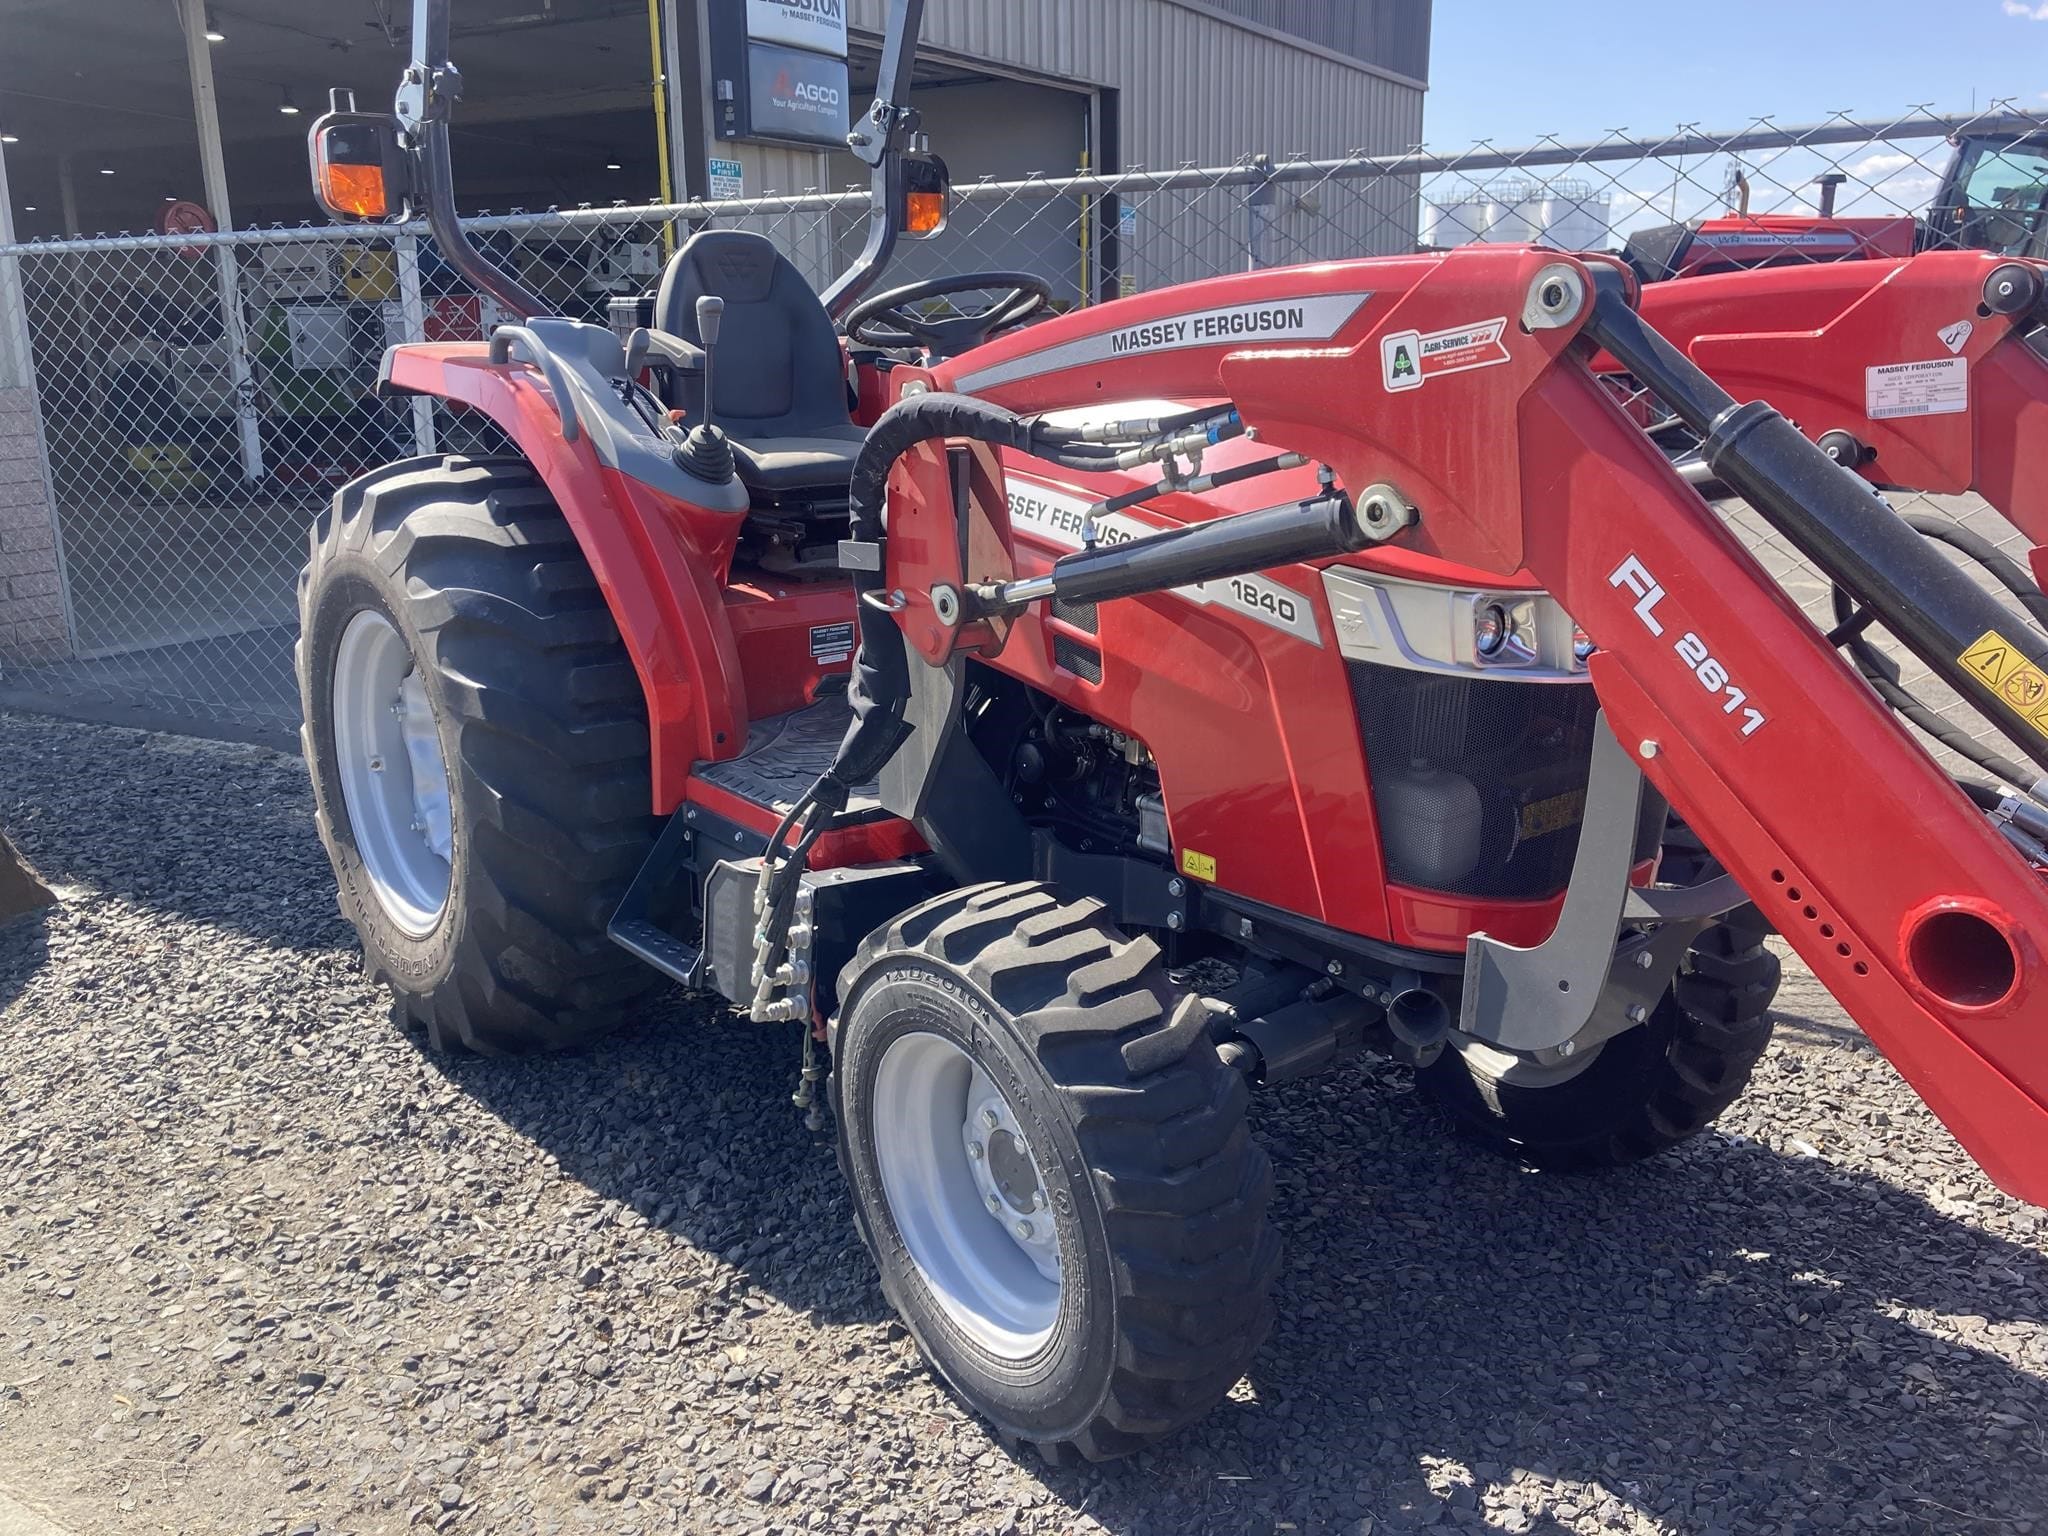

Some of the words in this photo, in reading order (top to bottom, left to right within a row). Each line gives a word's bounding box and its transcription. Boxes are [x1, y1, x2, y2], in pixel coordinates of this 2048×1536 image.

[758, 0, 841, 18] STON
[789, 9, 815, 21] MASSEY
[795, 82, 839, 105] AGCO
[772, 97, 786, 108] Your
[787, 100, 817, 112] Agriculture
[711, 161, 739, 171] SAFETY
[1111, 320, 1187, 353] MASSEY
[1193, 308, 1304, 339] FERGUSON
[1423, 335, 1469, 354] AGRI-SERVICE
[1877, 365, 1910, 375] MASSEY
[1911, 360, 1954, 371] FERGUSON
[1007, 493, 1048, 521] SSEY
[1050, 507, 1138, 546] FERUSO
[1231, 579, 1296, 622] 1840
[1607, 553, 1667, 639] FL
[1673, 630, 1766, 737] 2611
